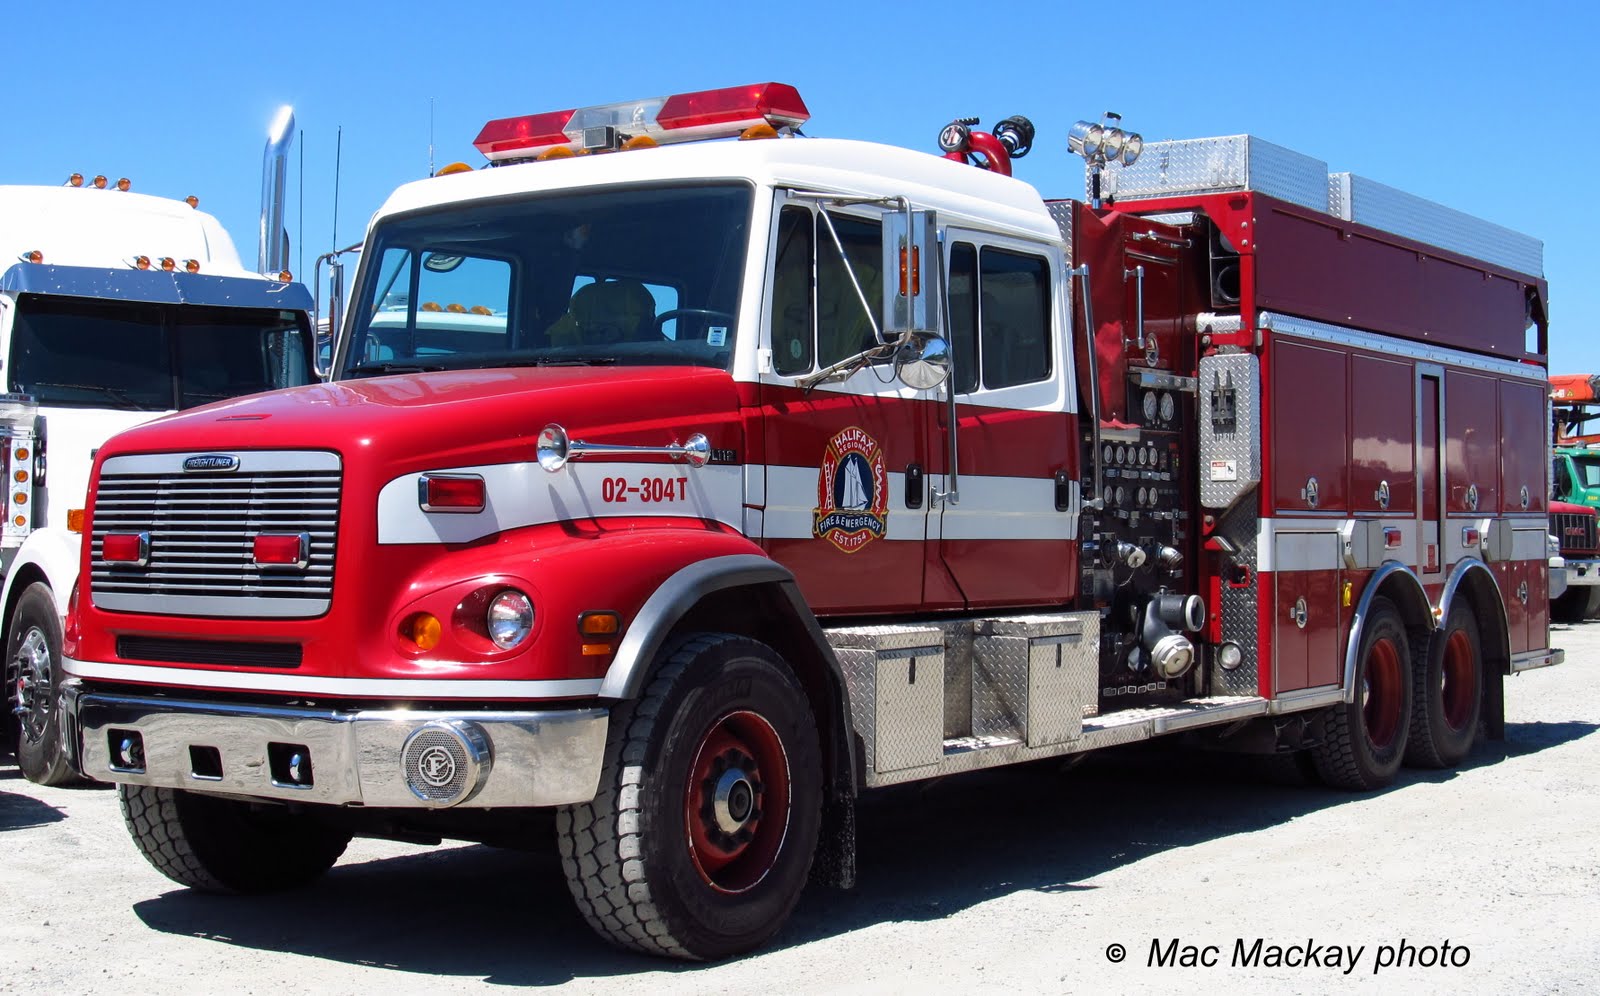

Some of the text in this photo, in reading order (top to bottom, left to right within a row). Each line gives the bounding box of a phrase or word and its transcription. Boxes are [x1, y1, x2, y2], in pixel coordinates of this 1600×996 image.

[835, 430, 874, 450] HALIFAX
[839, 442, 869, 456] REGIONAL
[187, 458, 230, 468] FREIGHTLINER
[602, 477, 688, 503] 02-304T
